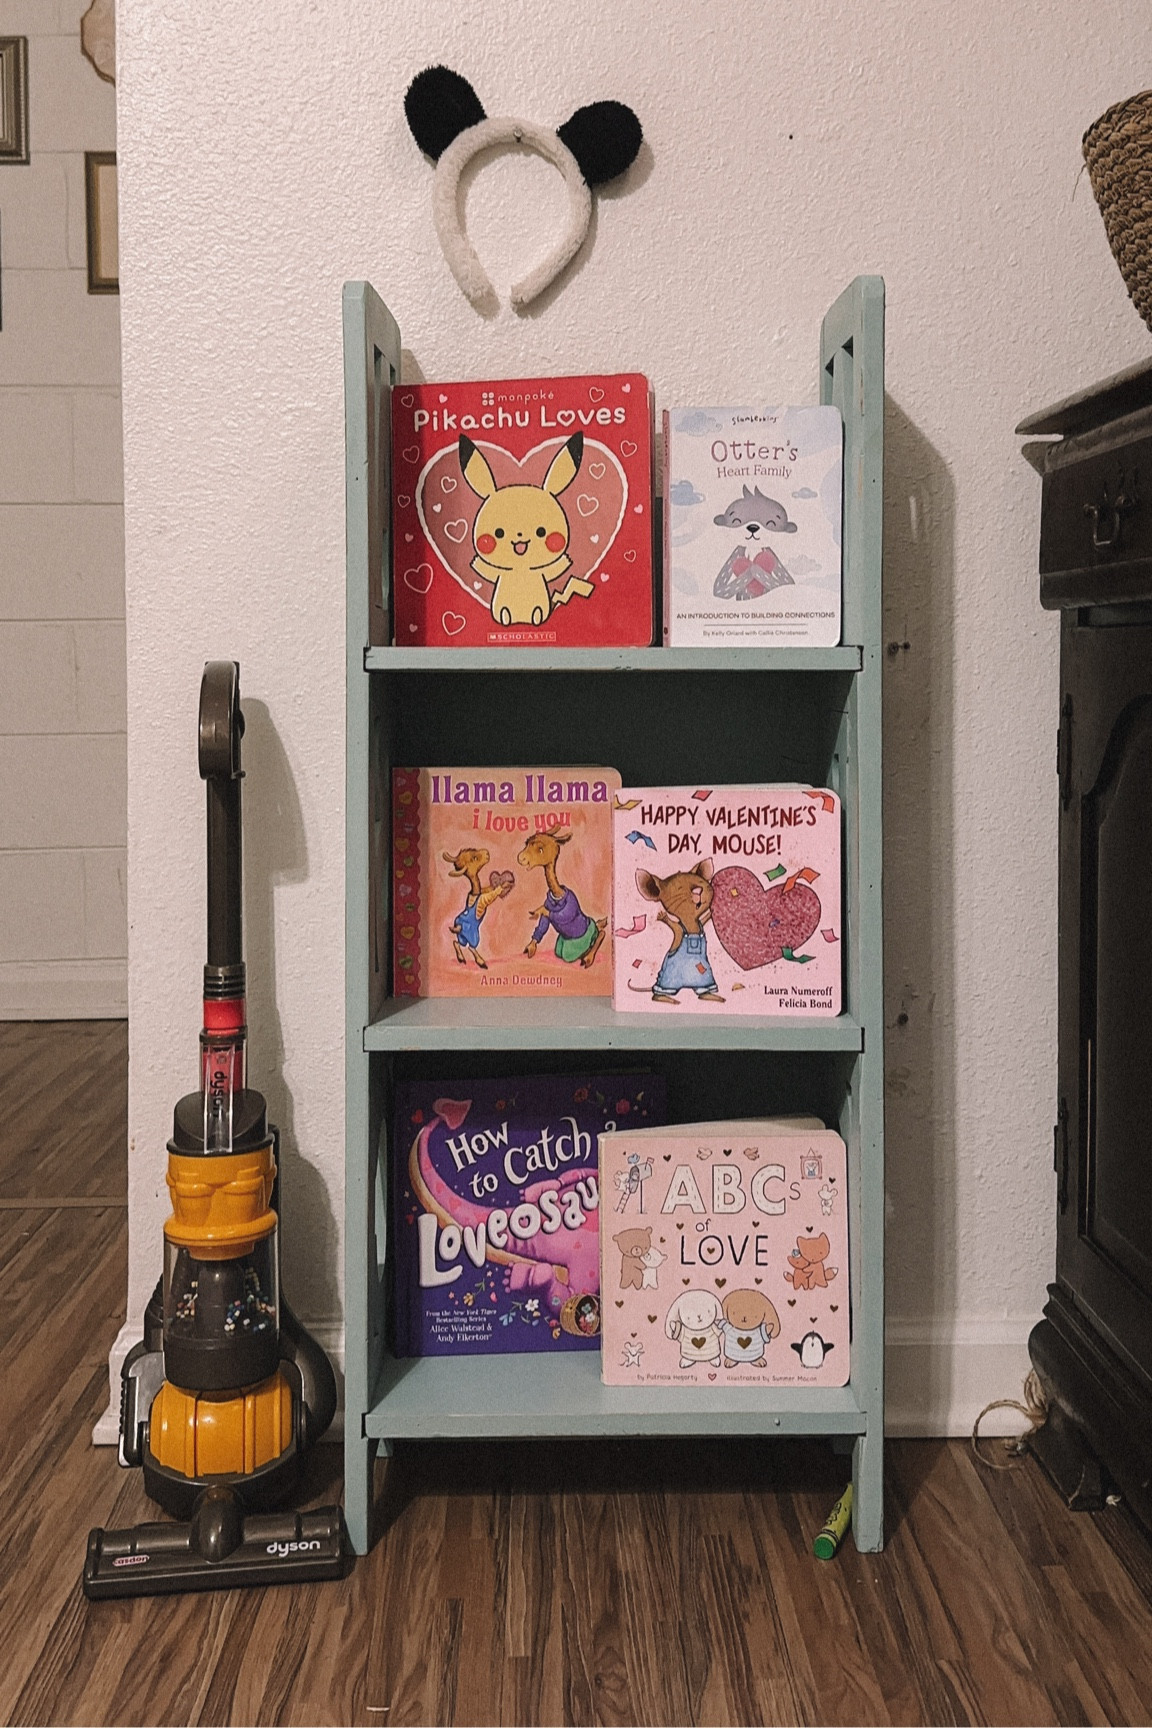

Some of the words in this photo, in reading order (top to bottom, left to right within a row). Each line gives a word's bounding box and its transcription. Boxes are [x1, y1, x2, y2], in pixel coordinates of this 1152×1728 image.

[414, 406, 530, 432] Pikachu
[540, 405, 626, 427] Loves
[711, 440, 798, 462] Otter's
[717, 466, 750, 478] Heart
[753, 464, 792, 480] Family
[688, 612, 739, 620] INTRODUCTION
[741, 612, 750, 620] TO
[751, 612, 784, 620] BUILDING
[785, 611, 836, 619] CONNECTIONS
[497, 632, 554, 640] SCHOLASTIC
[431, 775, 515, 804] llama
[525, 774, 608, 803] llama
[472, 808, 480, 829] i
[485, 810, 529, 832] love
[534, 811, 571, 834] you
[641, 804, 699, 826] HAPPY
[706, 805, 817, 829] VALENTINE'S
[668, 833, 702, 856] DAY,
[712, 834, 782, 856] MOUSE!
[480, 975, 509, 985] Anna
[512, 974, 562, 988] Dewdney
[764, 985, 789, 995] Laura
[791, 986, 833, 996] Numeroff
[779, 998, 807, 1008] Felicia
[810, 999, 833, 1008] Bond
[445, 1121, 509, 1173] How
[468, 1171, 498, 1198] to
[504, 1116, 591, 1184] Catch
[660, 1163, 801, 1216] ABCs
[695, 1218, 711, 1232] of
[680, 1235, 768, 1266] LOVE
[430, 1324, 449, 1333] Alice
[486, 1323, 493, 1331] &
[436, 1334, 454, 1343] Andy
[266, 1541, 321, 1558] dyson
